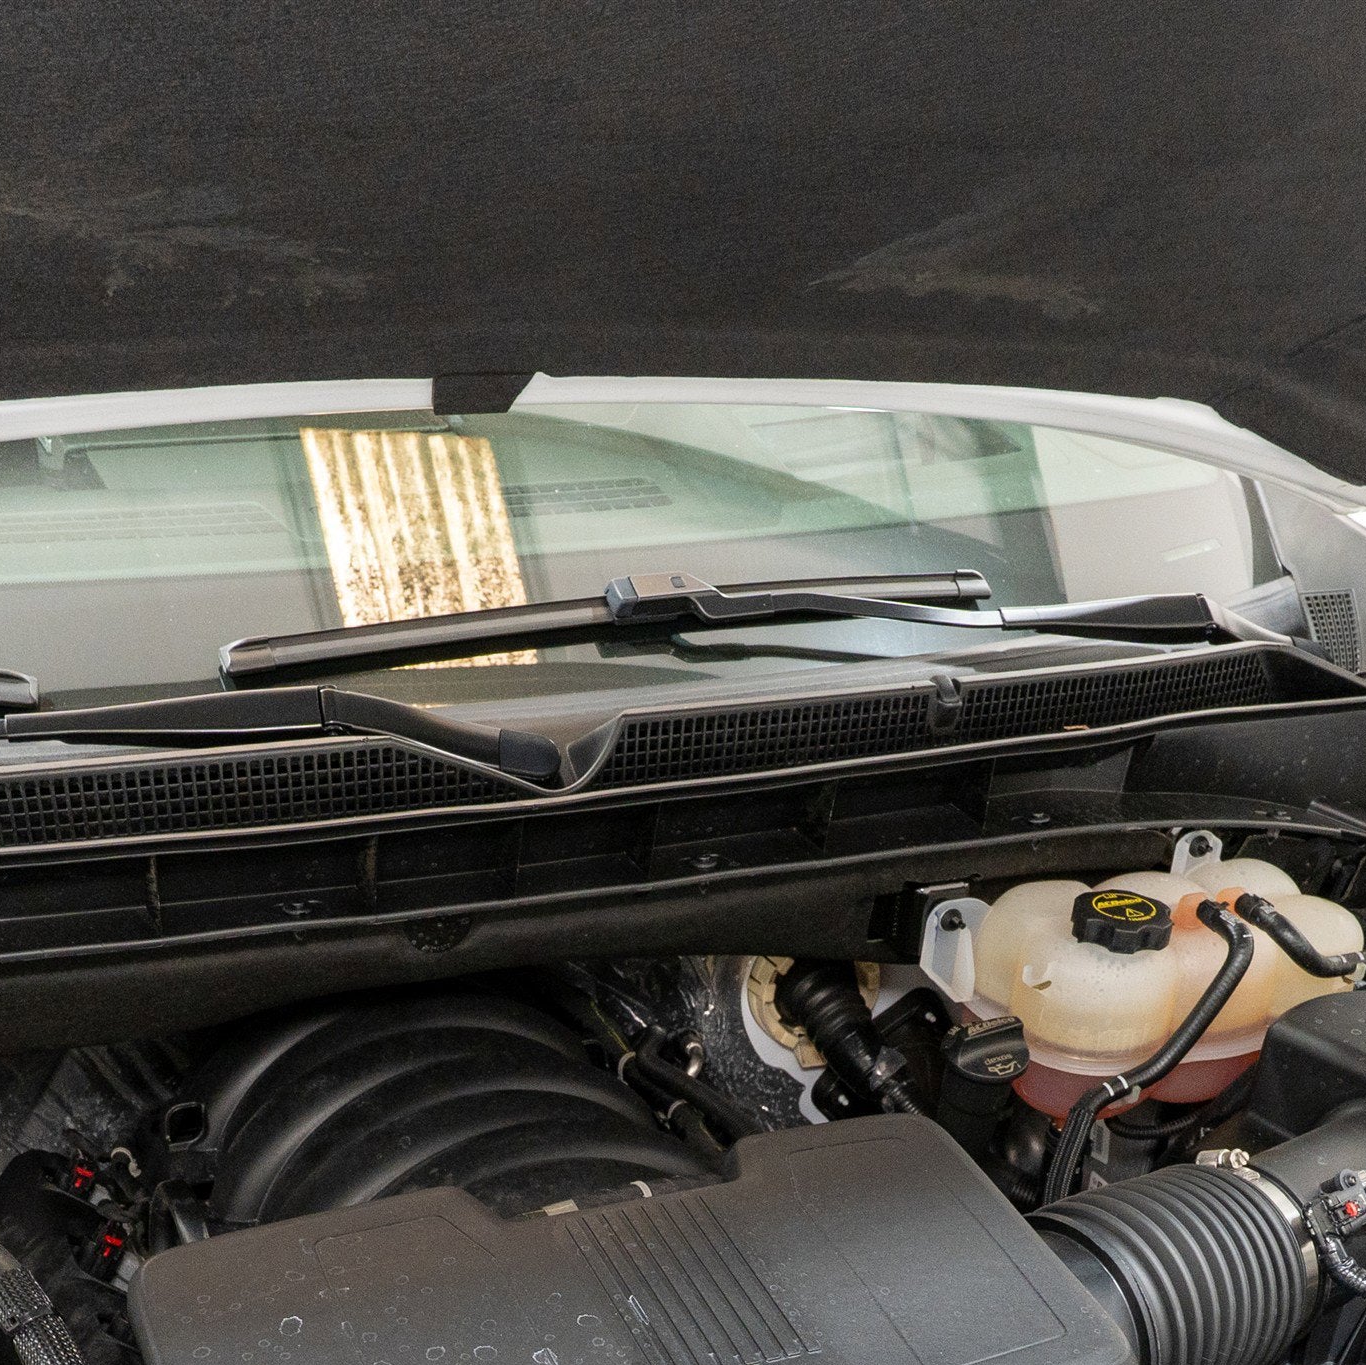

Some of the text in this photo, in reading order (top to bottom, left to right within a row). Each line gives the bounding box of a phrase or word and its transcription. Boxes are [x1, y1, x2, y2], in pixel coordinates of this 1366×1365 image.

[1097, 898, 1143, 909] ACDelco
[968, 1018, 1016, 1036] ACDelco
[984, 1053, 1013, 1065] dexos
